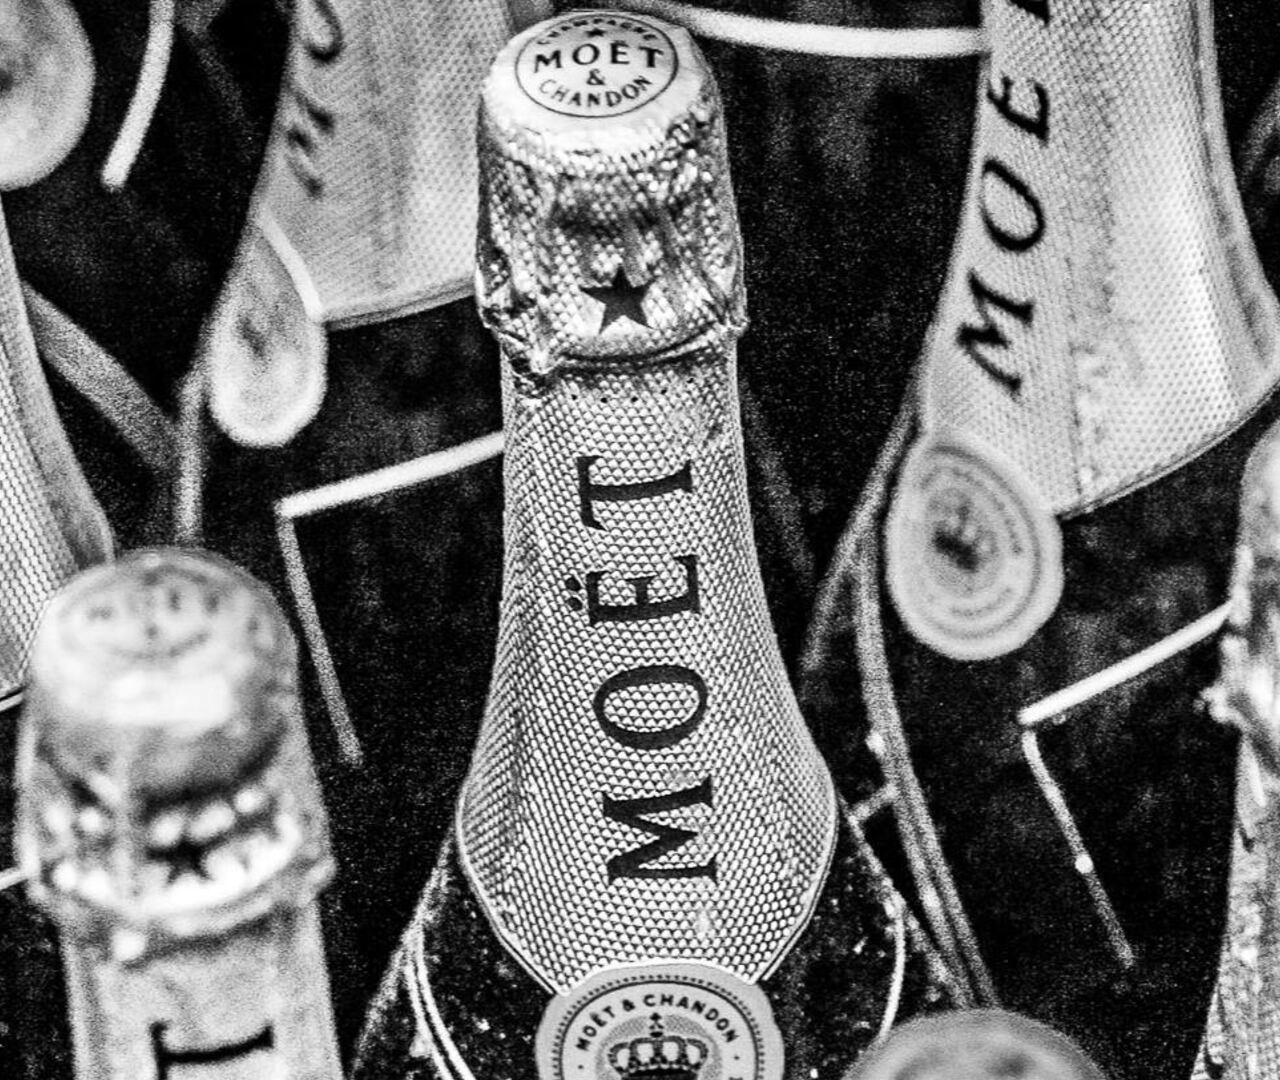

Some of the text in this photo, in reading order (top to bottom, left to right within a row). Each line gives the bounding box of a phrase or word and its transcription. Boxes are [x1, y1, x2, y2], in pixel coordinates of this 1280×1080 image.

[539, 74, 653, 107] CHANDON
[586, 68, 606, 86] &
[565, 455, 719, 885] MOËT
[622, 999, 636, 1013] &
[642, 993, 740, 1043] CHANDON
